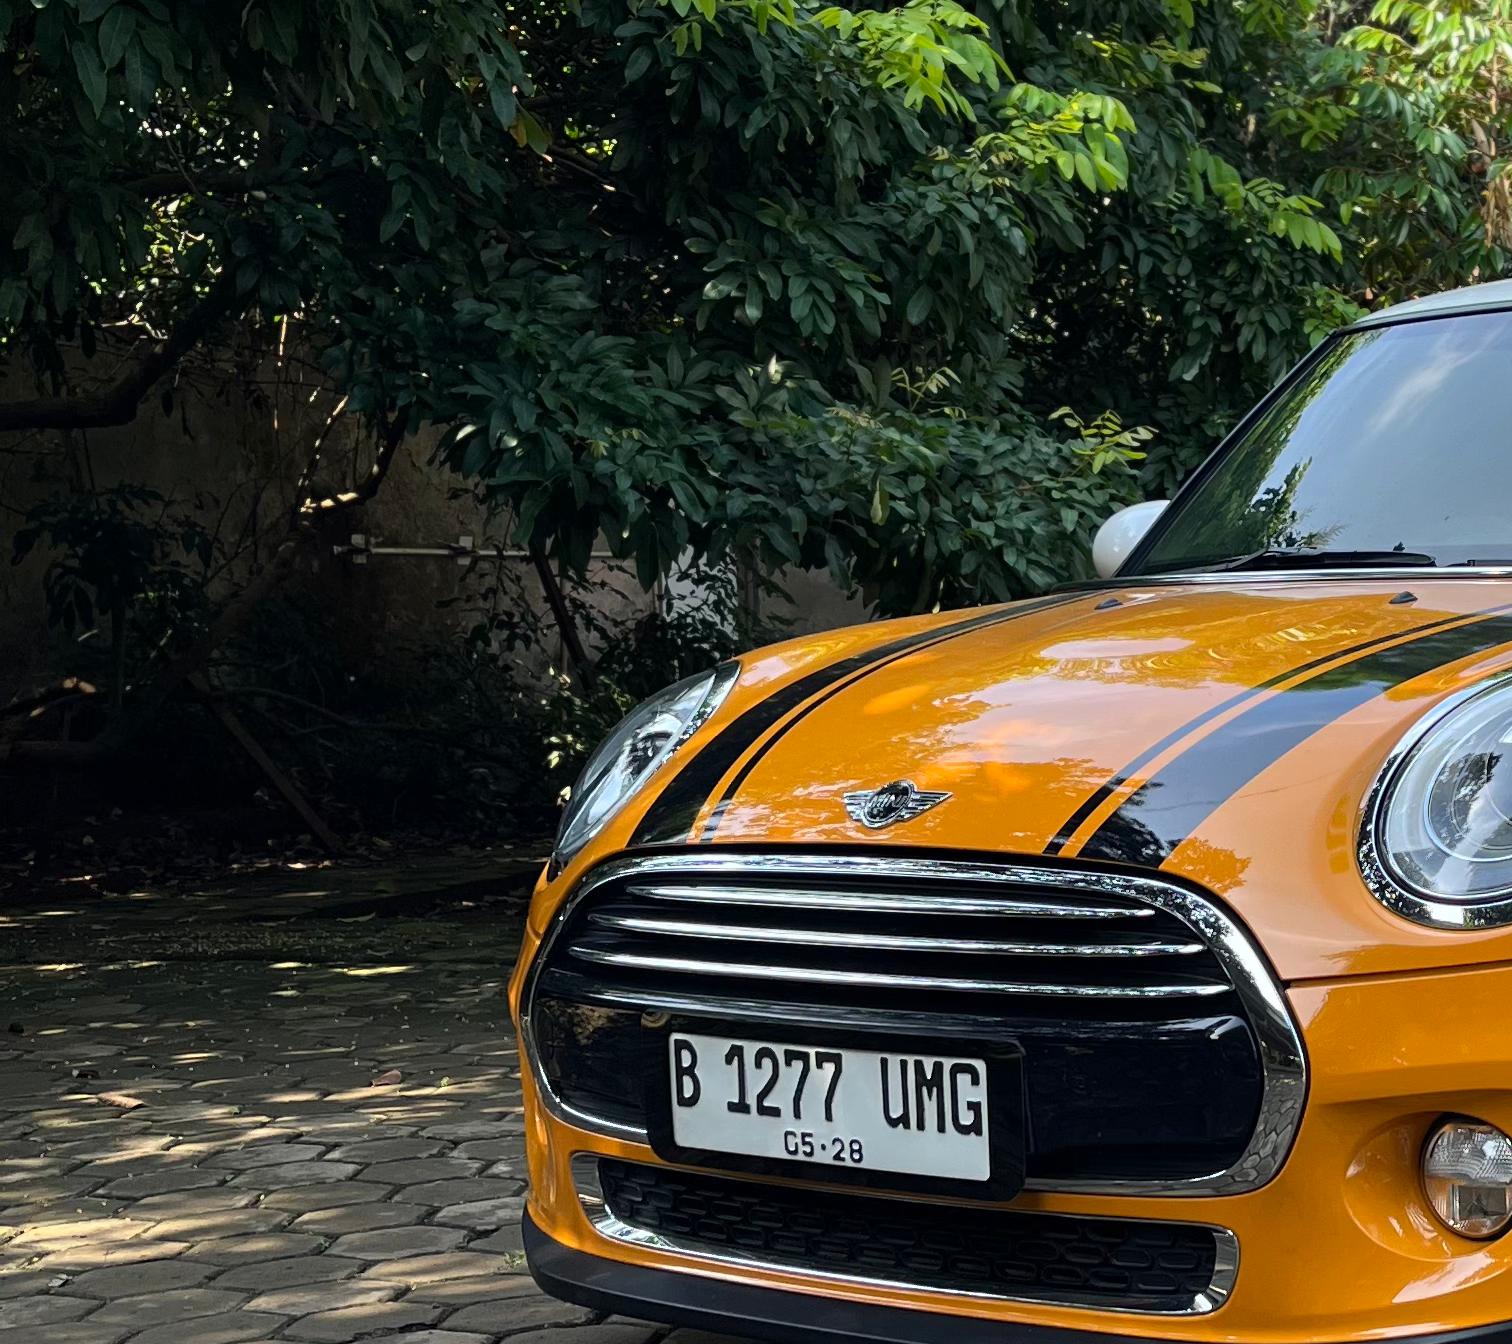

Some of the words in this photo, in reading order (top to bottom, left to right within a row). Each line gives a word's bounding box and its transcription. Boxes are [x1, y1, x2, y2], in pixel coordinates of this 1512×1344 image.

[674, 1038, 701, 1107] B
[724, 1044, 843, 1122] 1277
[880, 1056, 984, 1137] UMG
